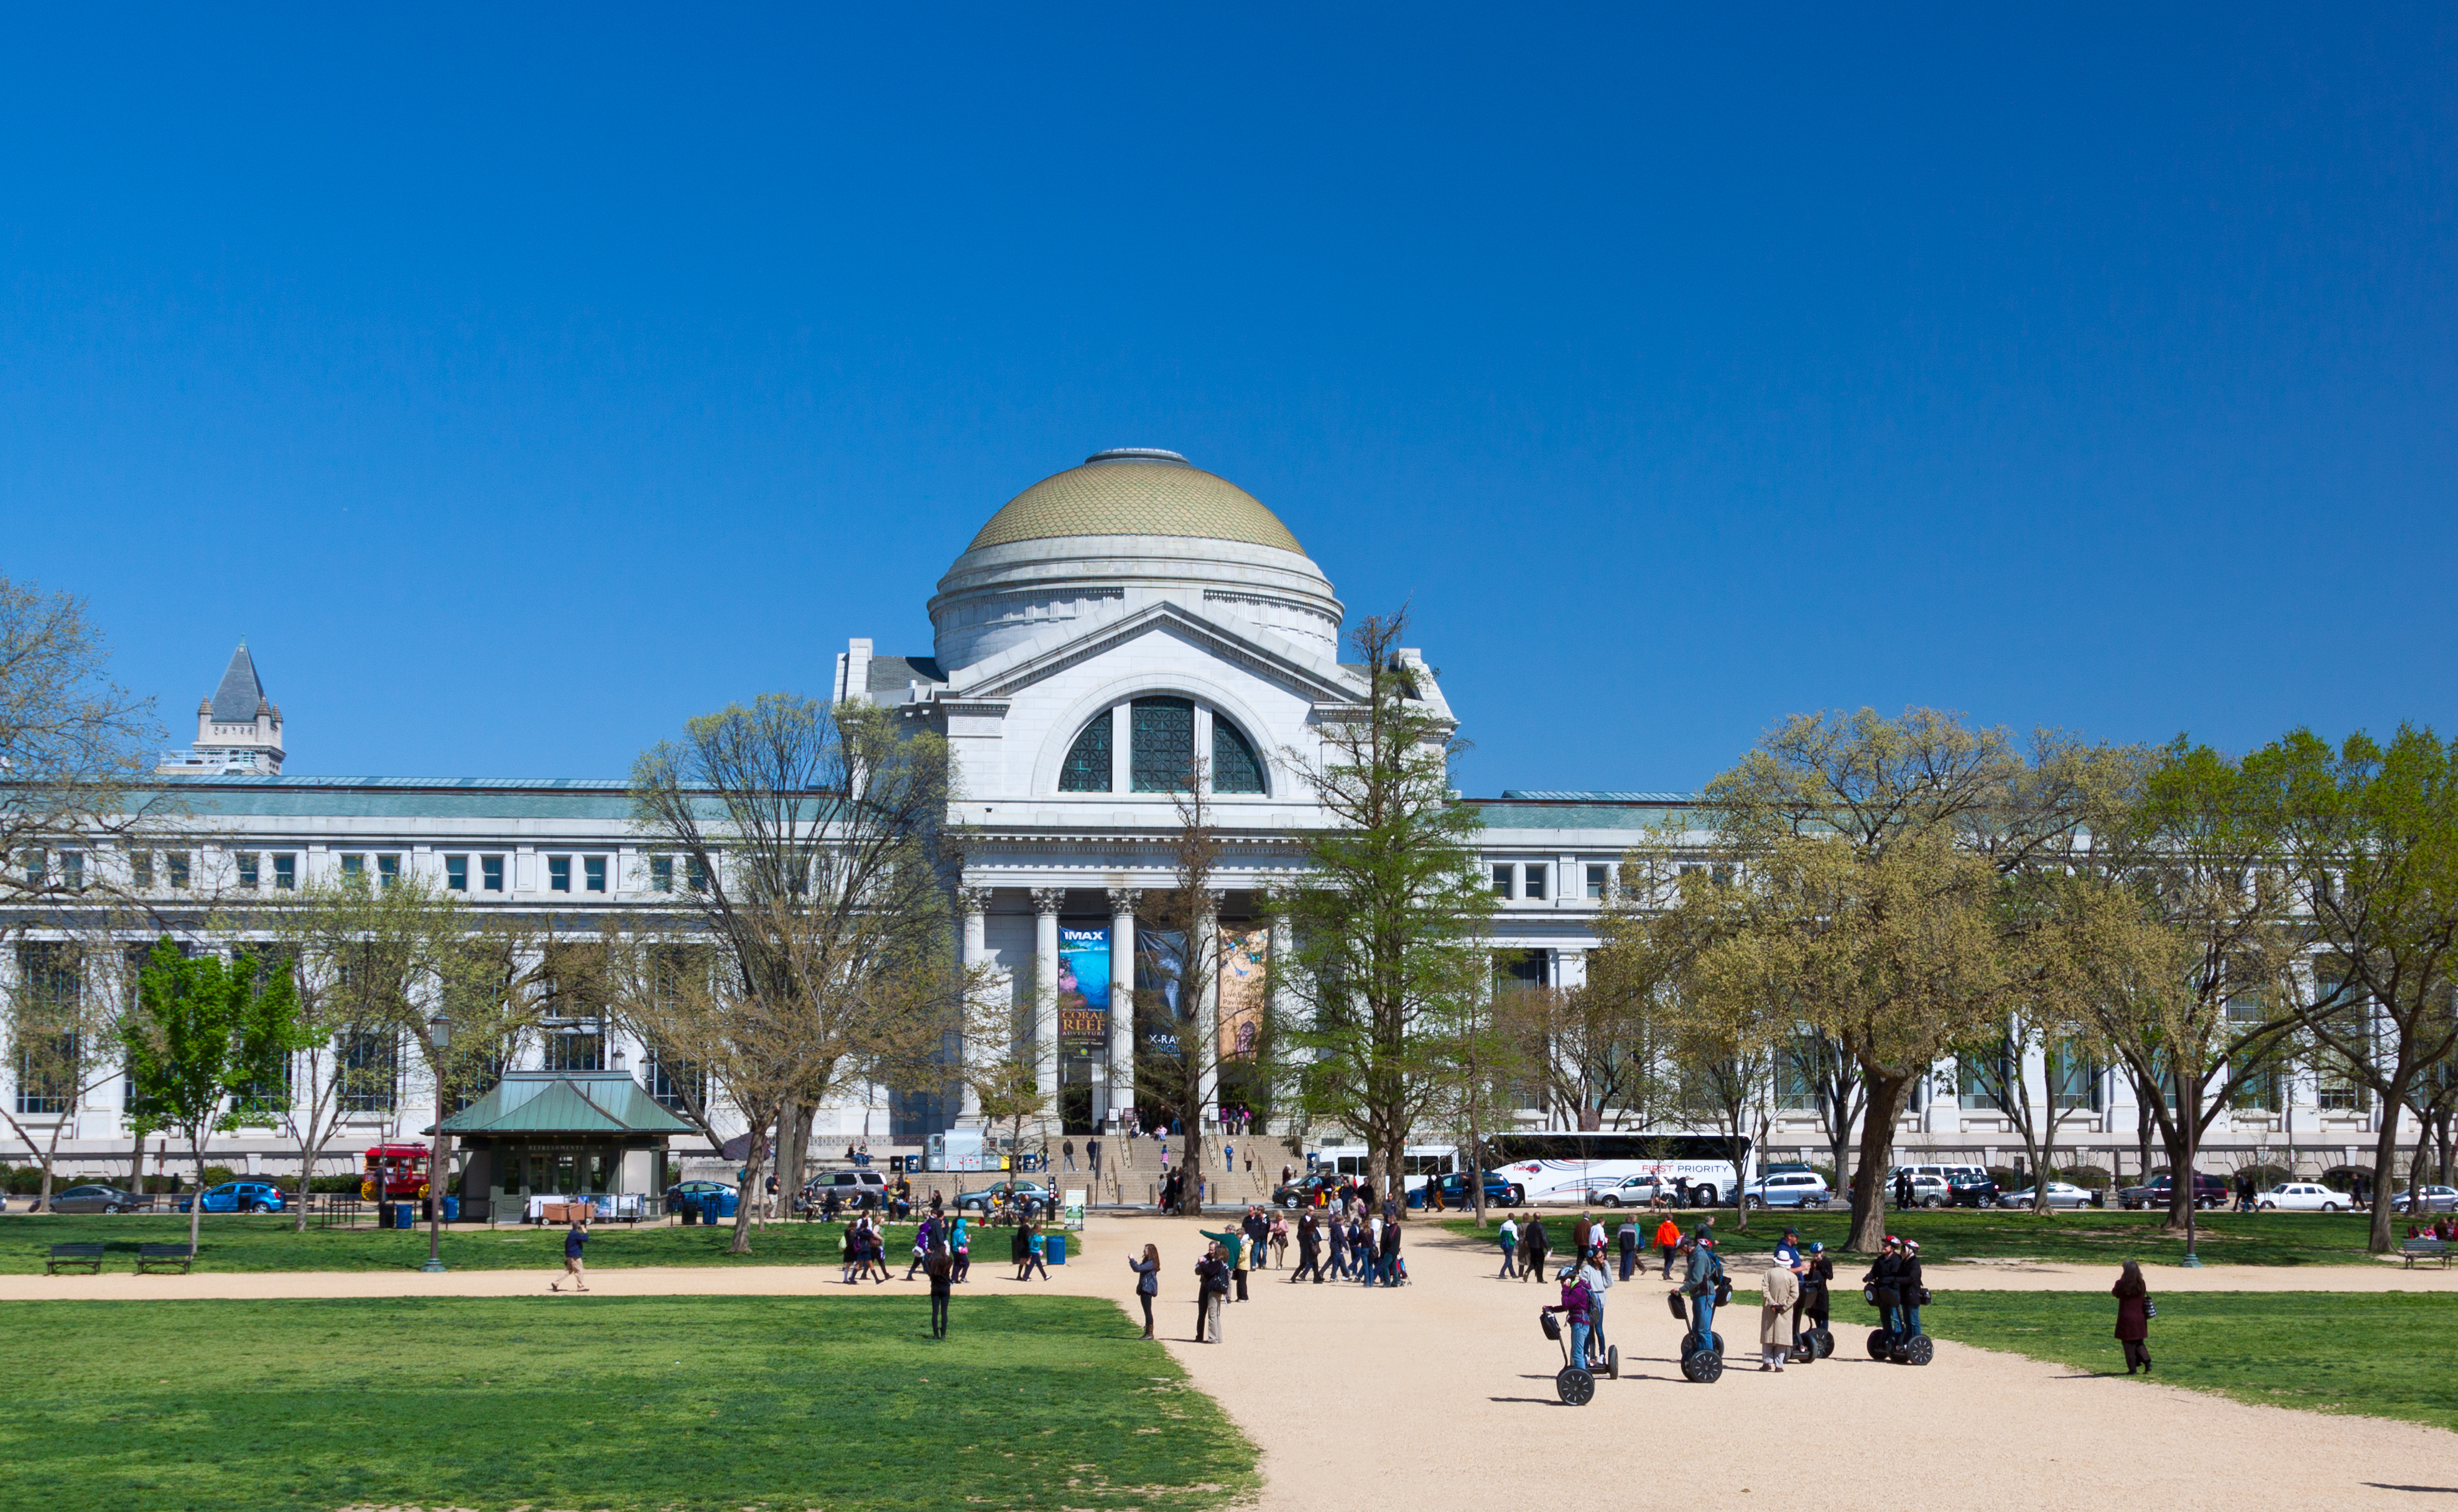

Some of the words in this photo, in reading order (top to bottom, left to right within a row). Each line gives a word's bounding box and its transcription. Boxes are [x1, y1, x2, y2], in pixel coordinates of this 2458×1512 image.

[1064, 931, 1103, 940] IMAX
[1062, 1011, 1105, 1019] CORAL
[1062, 1019, 1105, 1031] REEF
[1149, 1034, 1181, 1044] X-RAY
